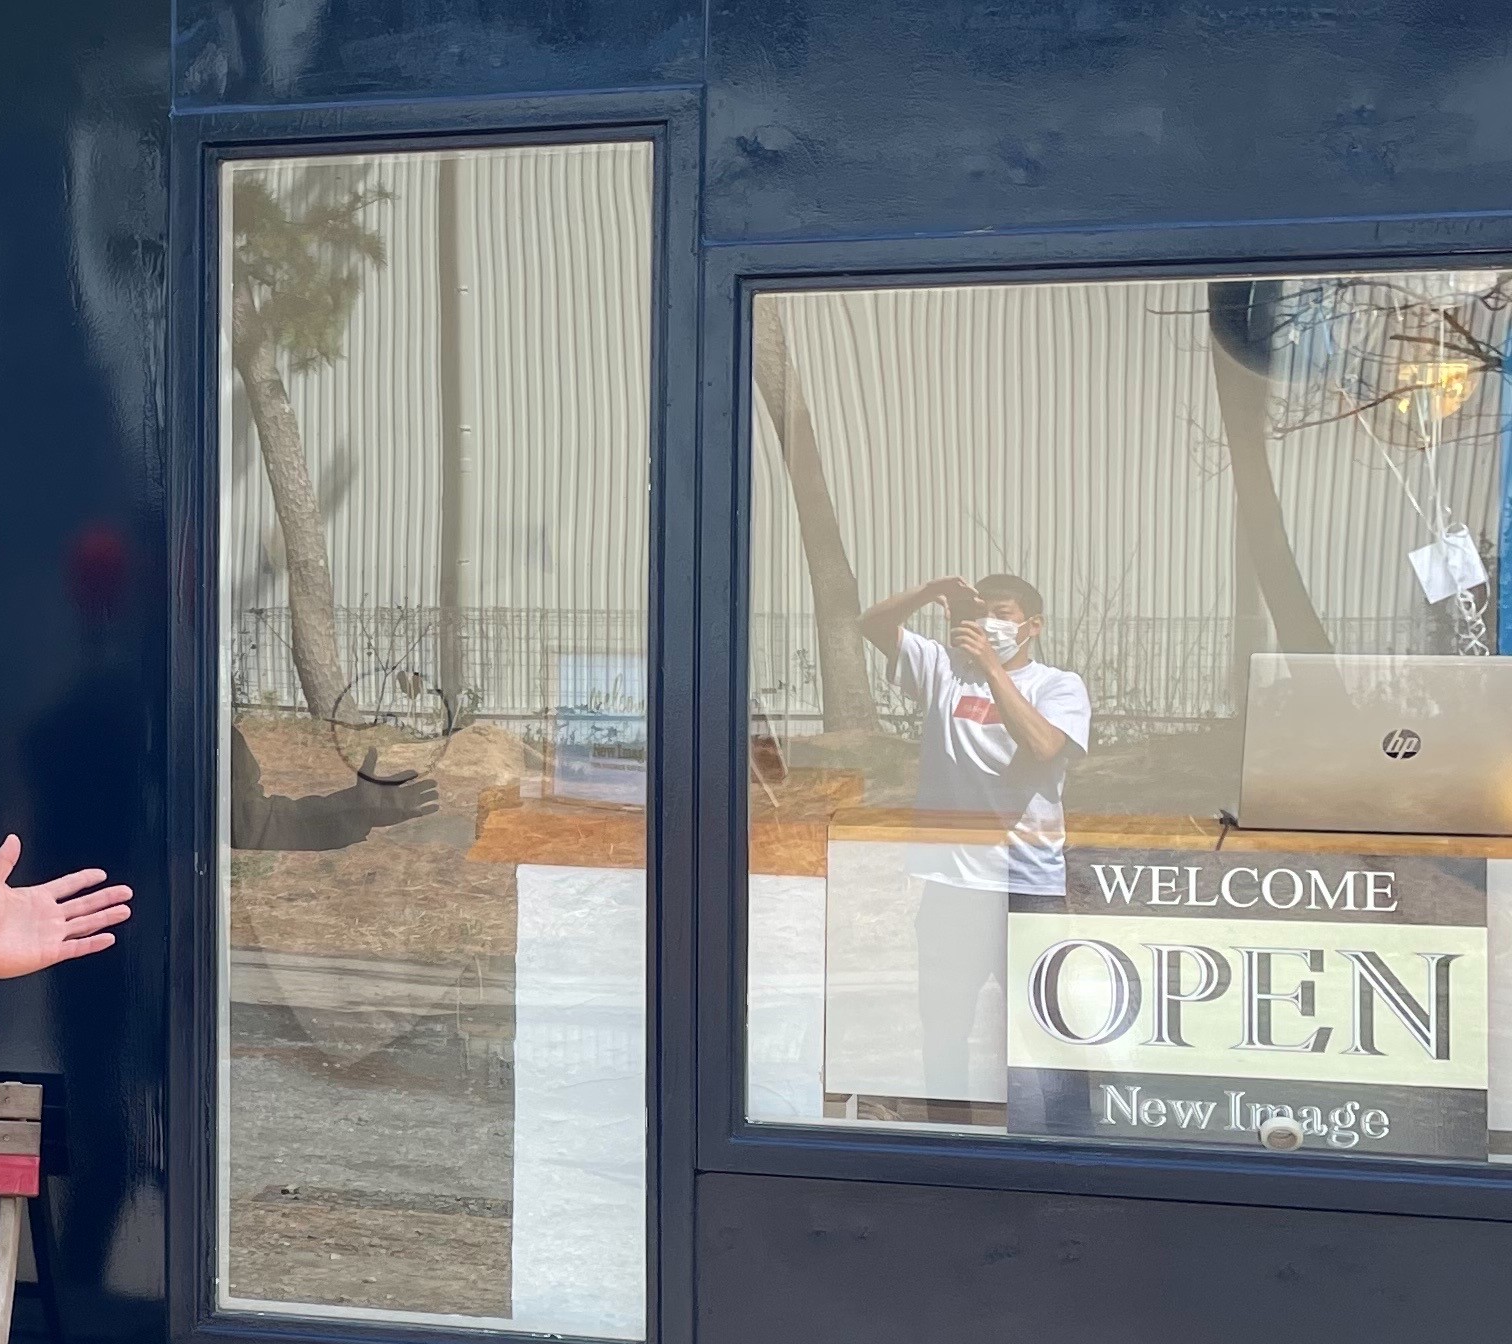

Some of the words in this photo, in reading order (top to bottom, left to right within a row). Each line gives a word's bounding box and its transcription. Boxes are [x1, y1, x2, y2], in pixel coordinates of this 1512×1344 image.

[1385, 728, 1419, 760] hp
[1089, 864, 1399, 912] WELCOME
[1027, 938, 1465, 1061] OPEN
[1098, 1084, 1218, 1130] New
[1223, 1090, 1391, 1149] Image
